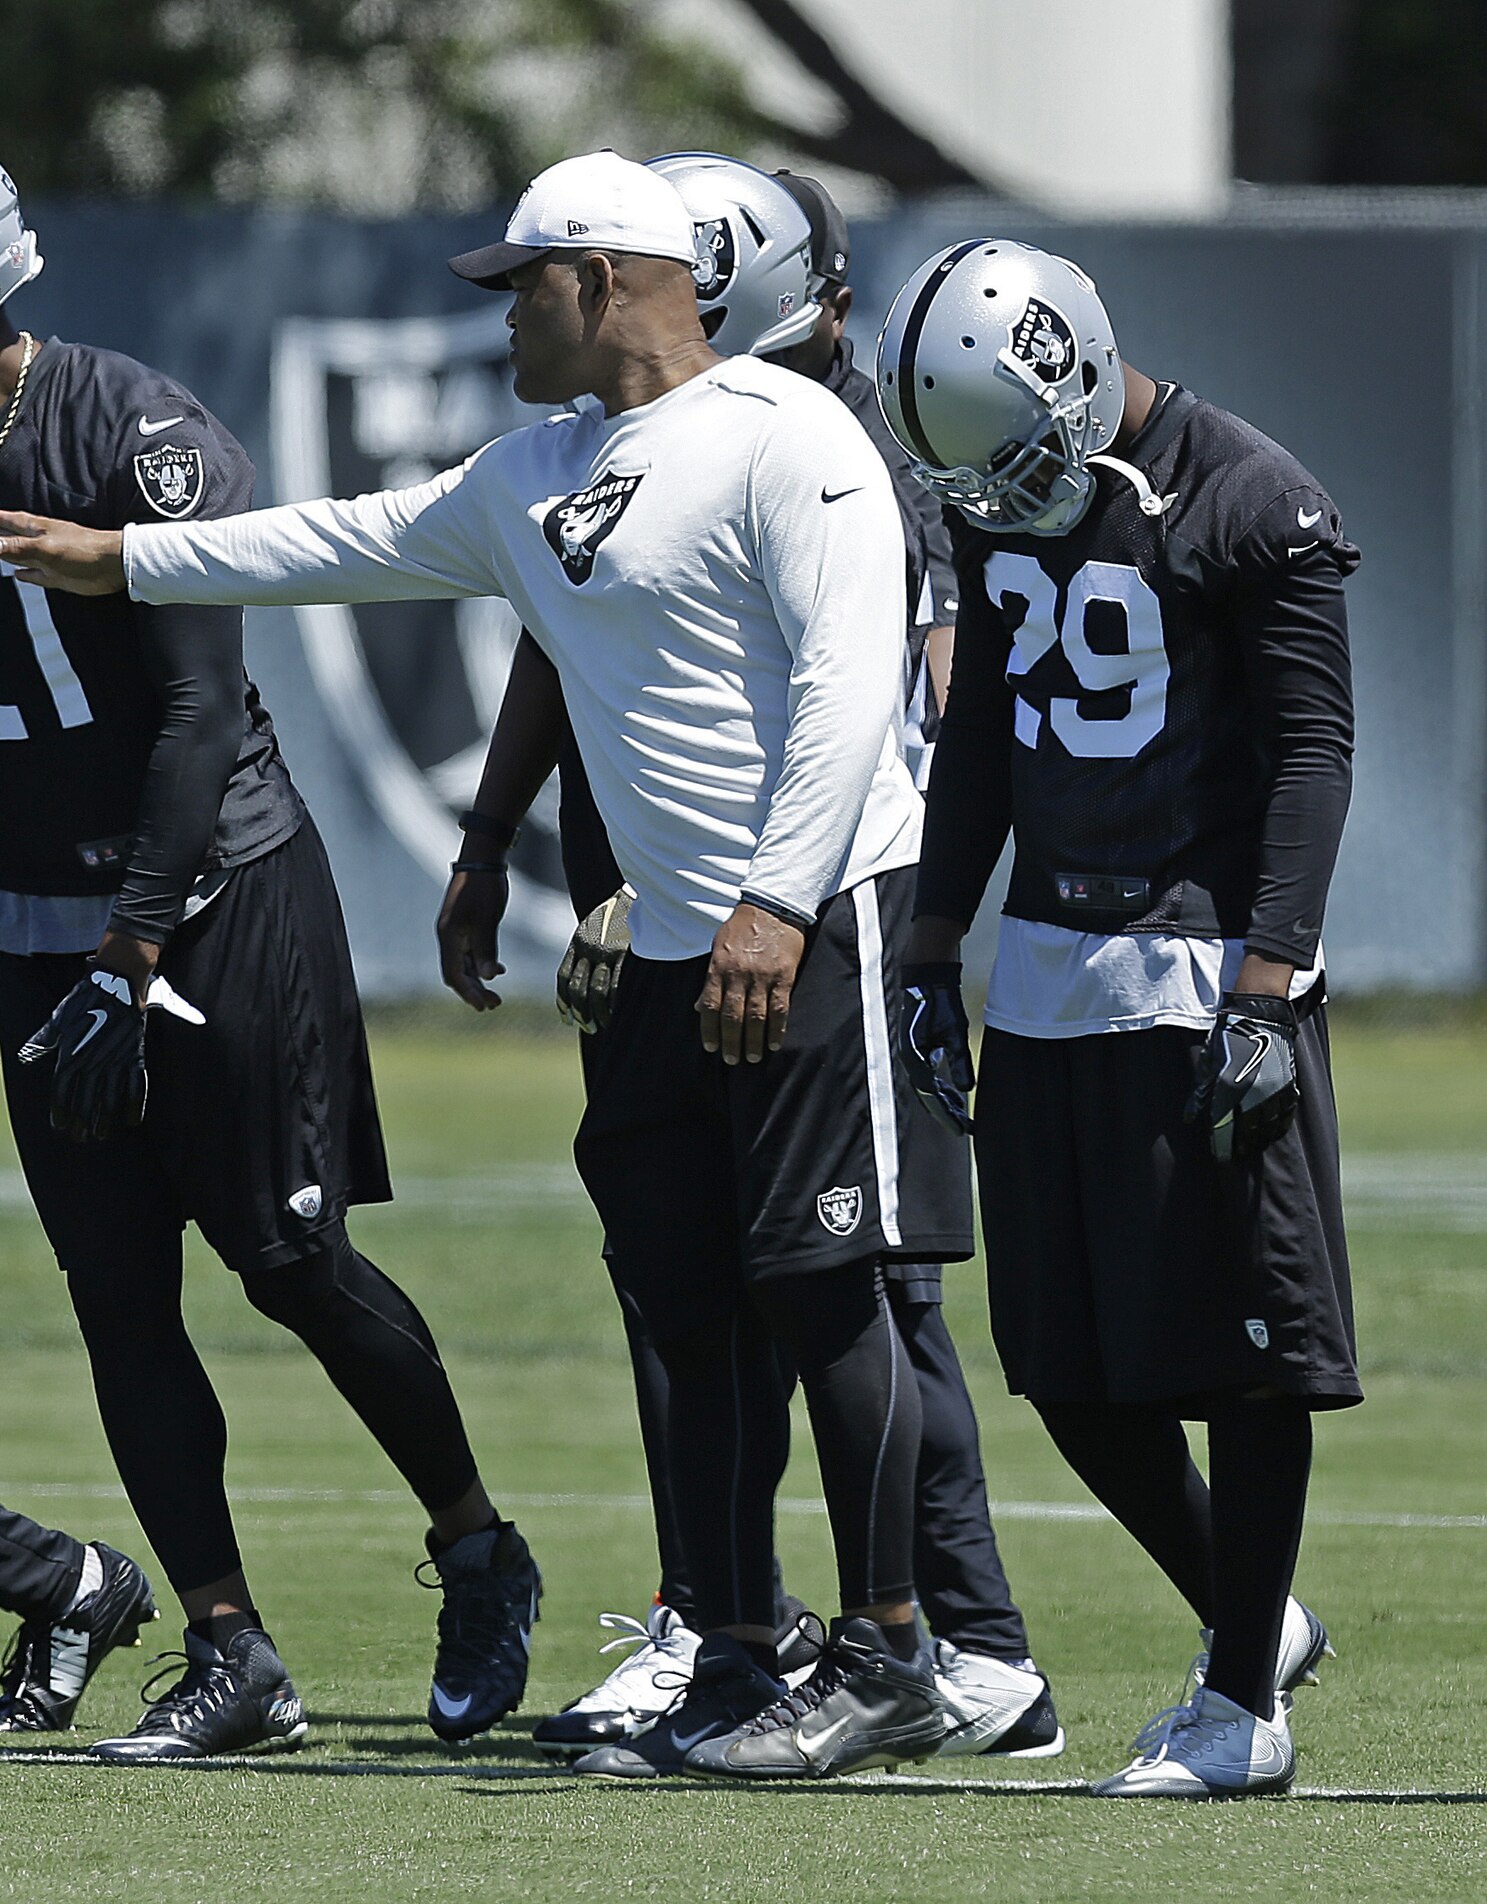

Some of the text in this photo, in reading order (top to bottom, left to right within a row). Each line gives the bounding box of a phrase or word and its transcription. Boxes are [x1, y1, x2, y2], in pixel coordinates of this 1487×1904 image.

[1014, 304, 1038, 357] AIDERS
[571, 478, 636, 505] RAIDERS
[983, 551, 1170, 757] 29
